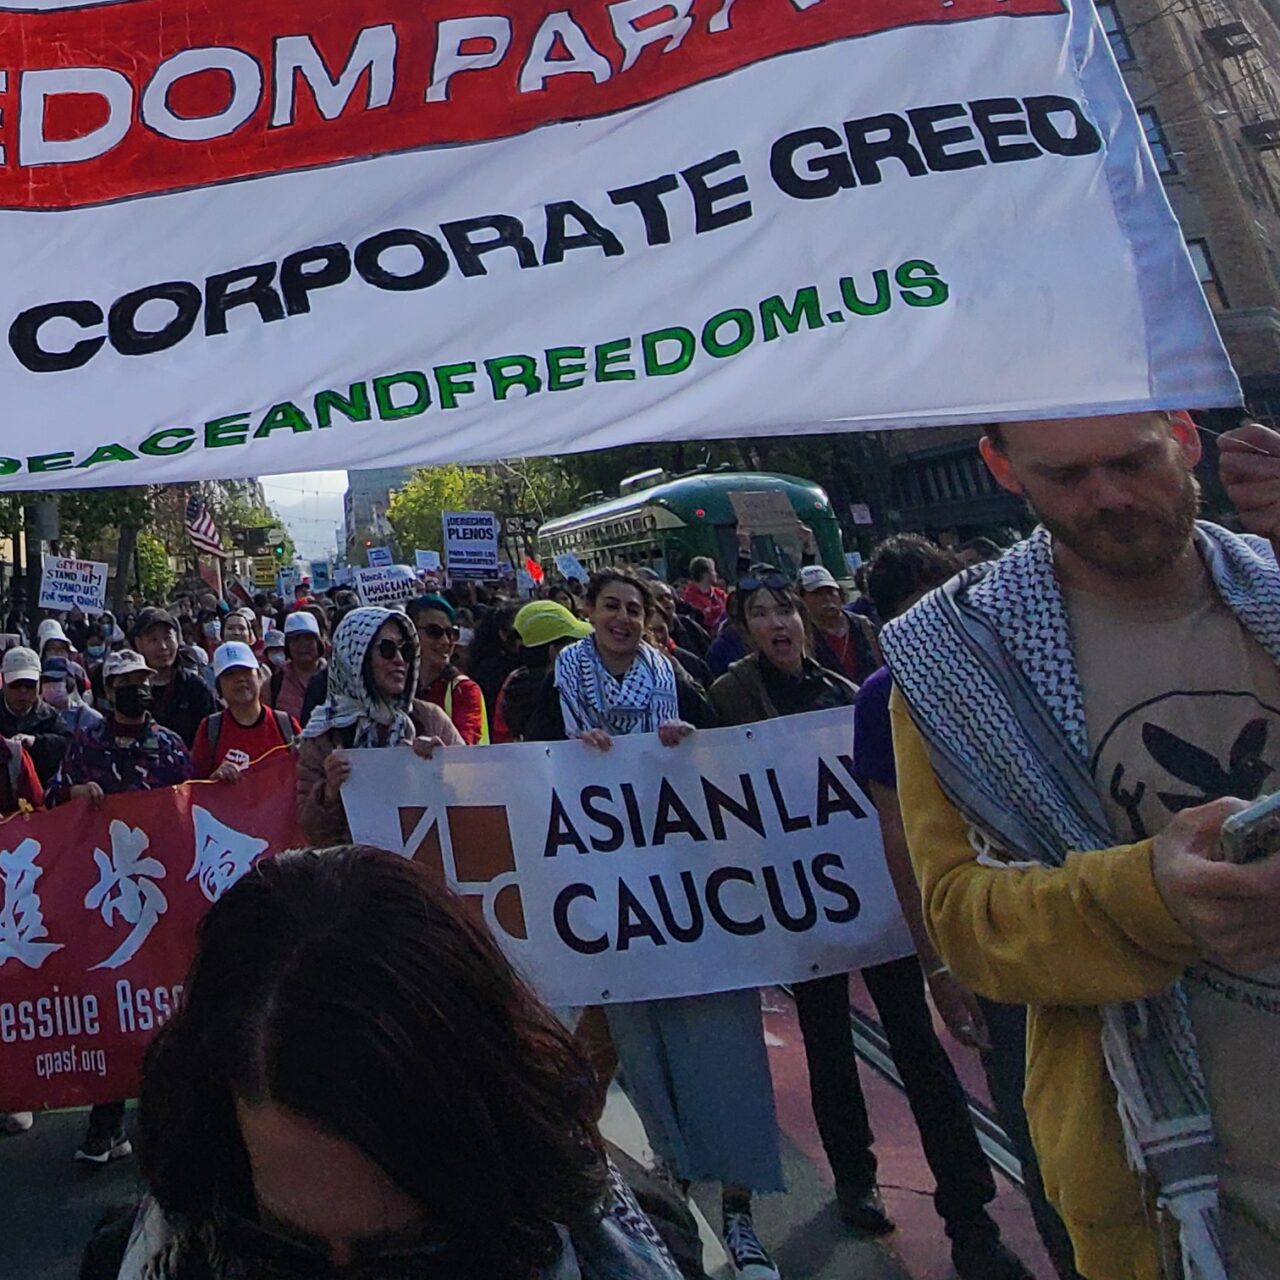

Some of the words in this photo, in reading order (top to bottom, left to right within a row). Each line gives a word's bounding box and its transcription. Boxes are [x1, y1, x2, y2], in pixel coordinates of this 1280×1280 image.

[8, 149, 754, 374] CORPORATE
[769, 94, 1103, 200] GREED
[447, 527, 494, 540] PLENOS
[46, 568, 78, 581] STAND
[51, 581, 82, 593] STAND
[543, 773, 768, 858] ASIAN
[552, 852, 861, 955] CAUCUS
[35, 1044, 108, 1080] cpasf.org
